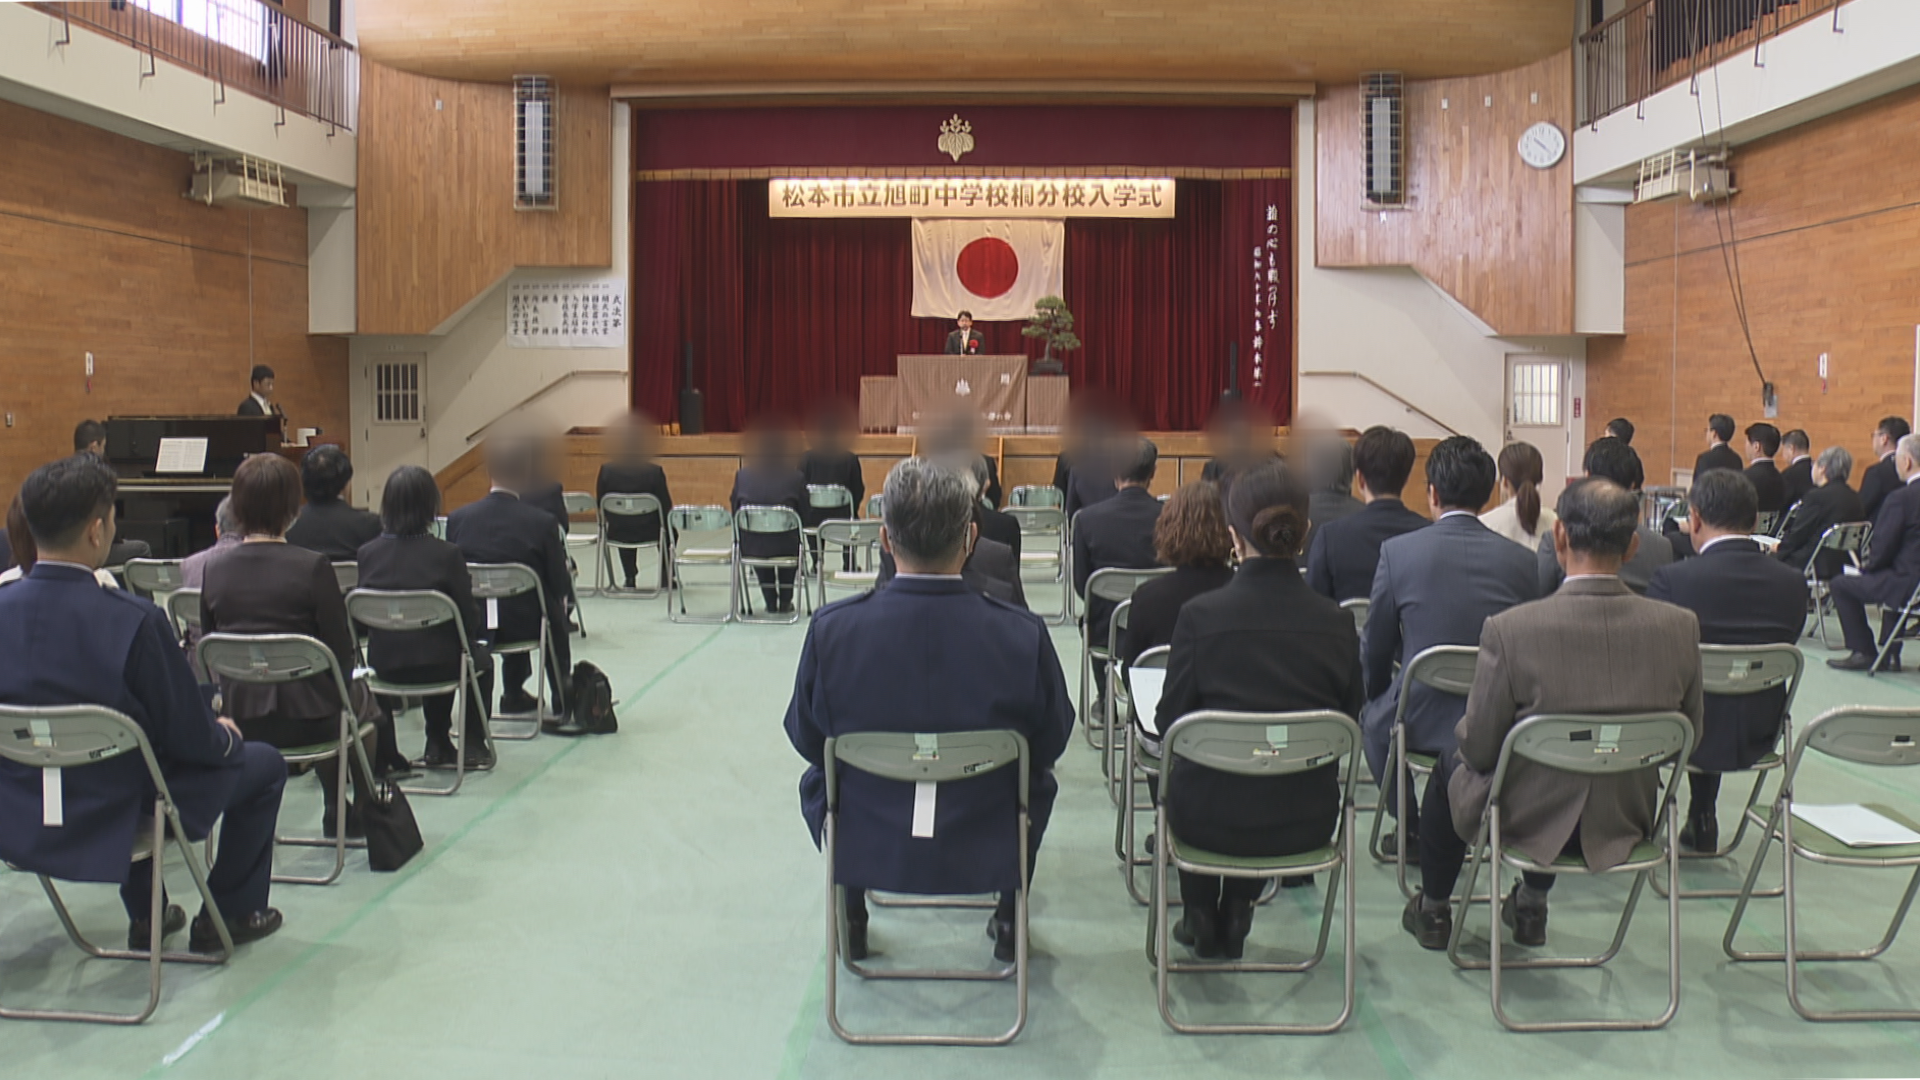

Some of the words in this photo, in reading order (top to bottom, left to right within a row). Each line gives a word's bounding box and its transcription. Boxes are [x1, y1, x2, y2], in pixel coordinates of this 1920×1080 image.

[782, 183, 1162, 208] 松本市立旭町中学校桐分校入学式
